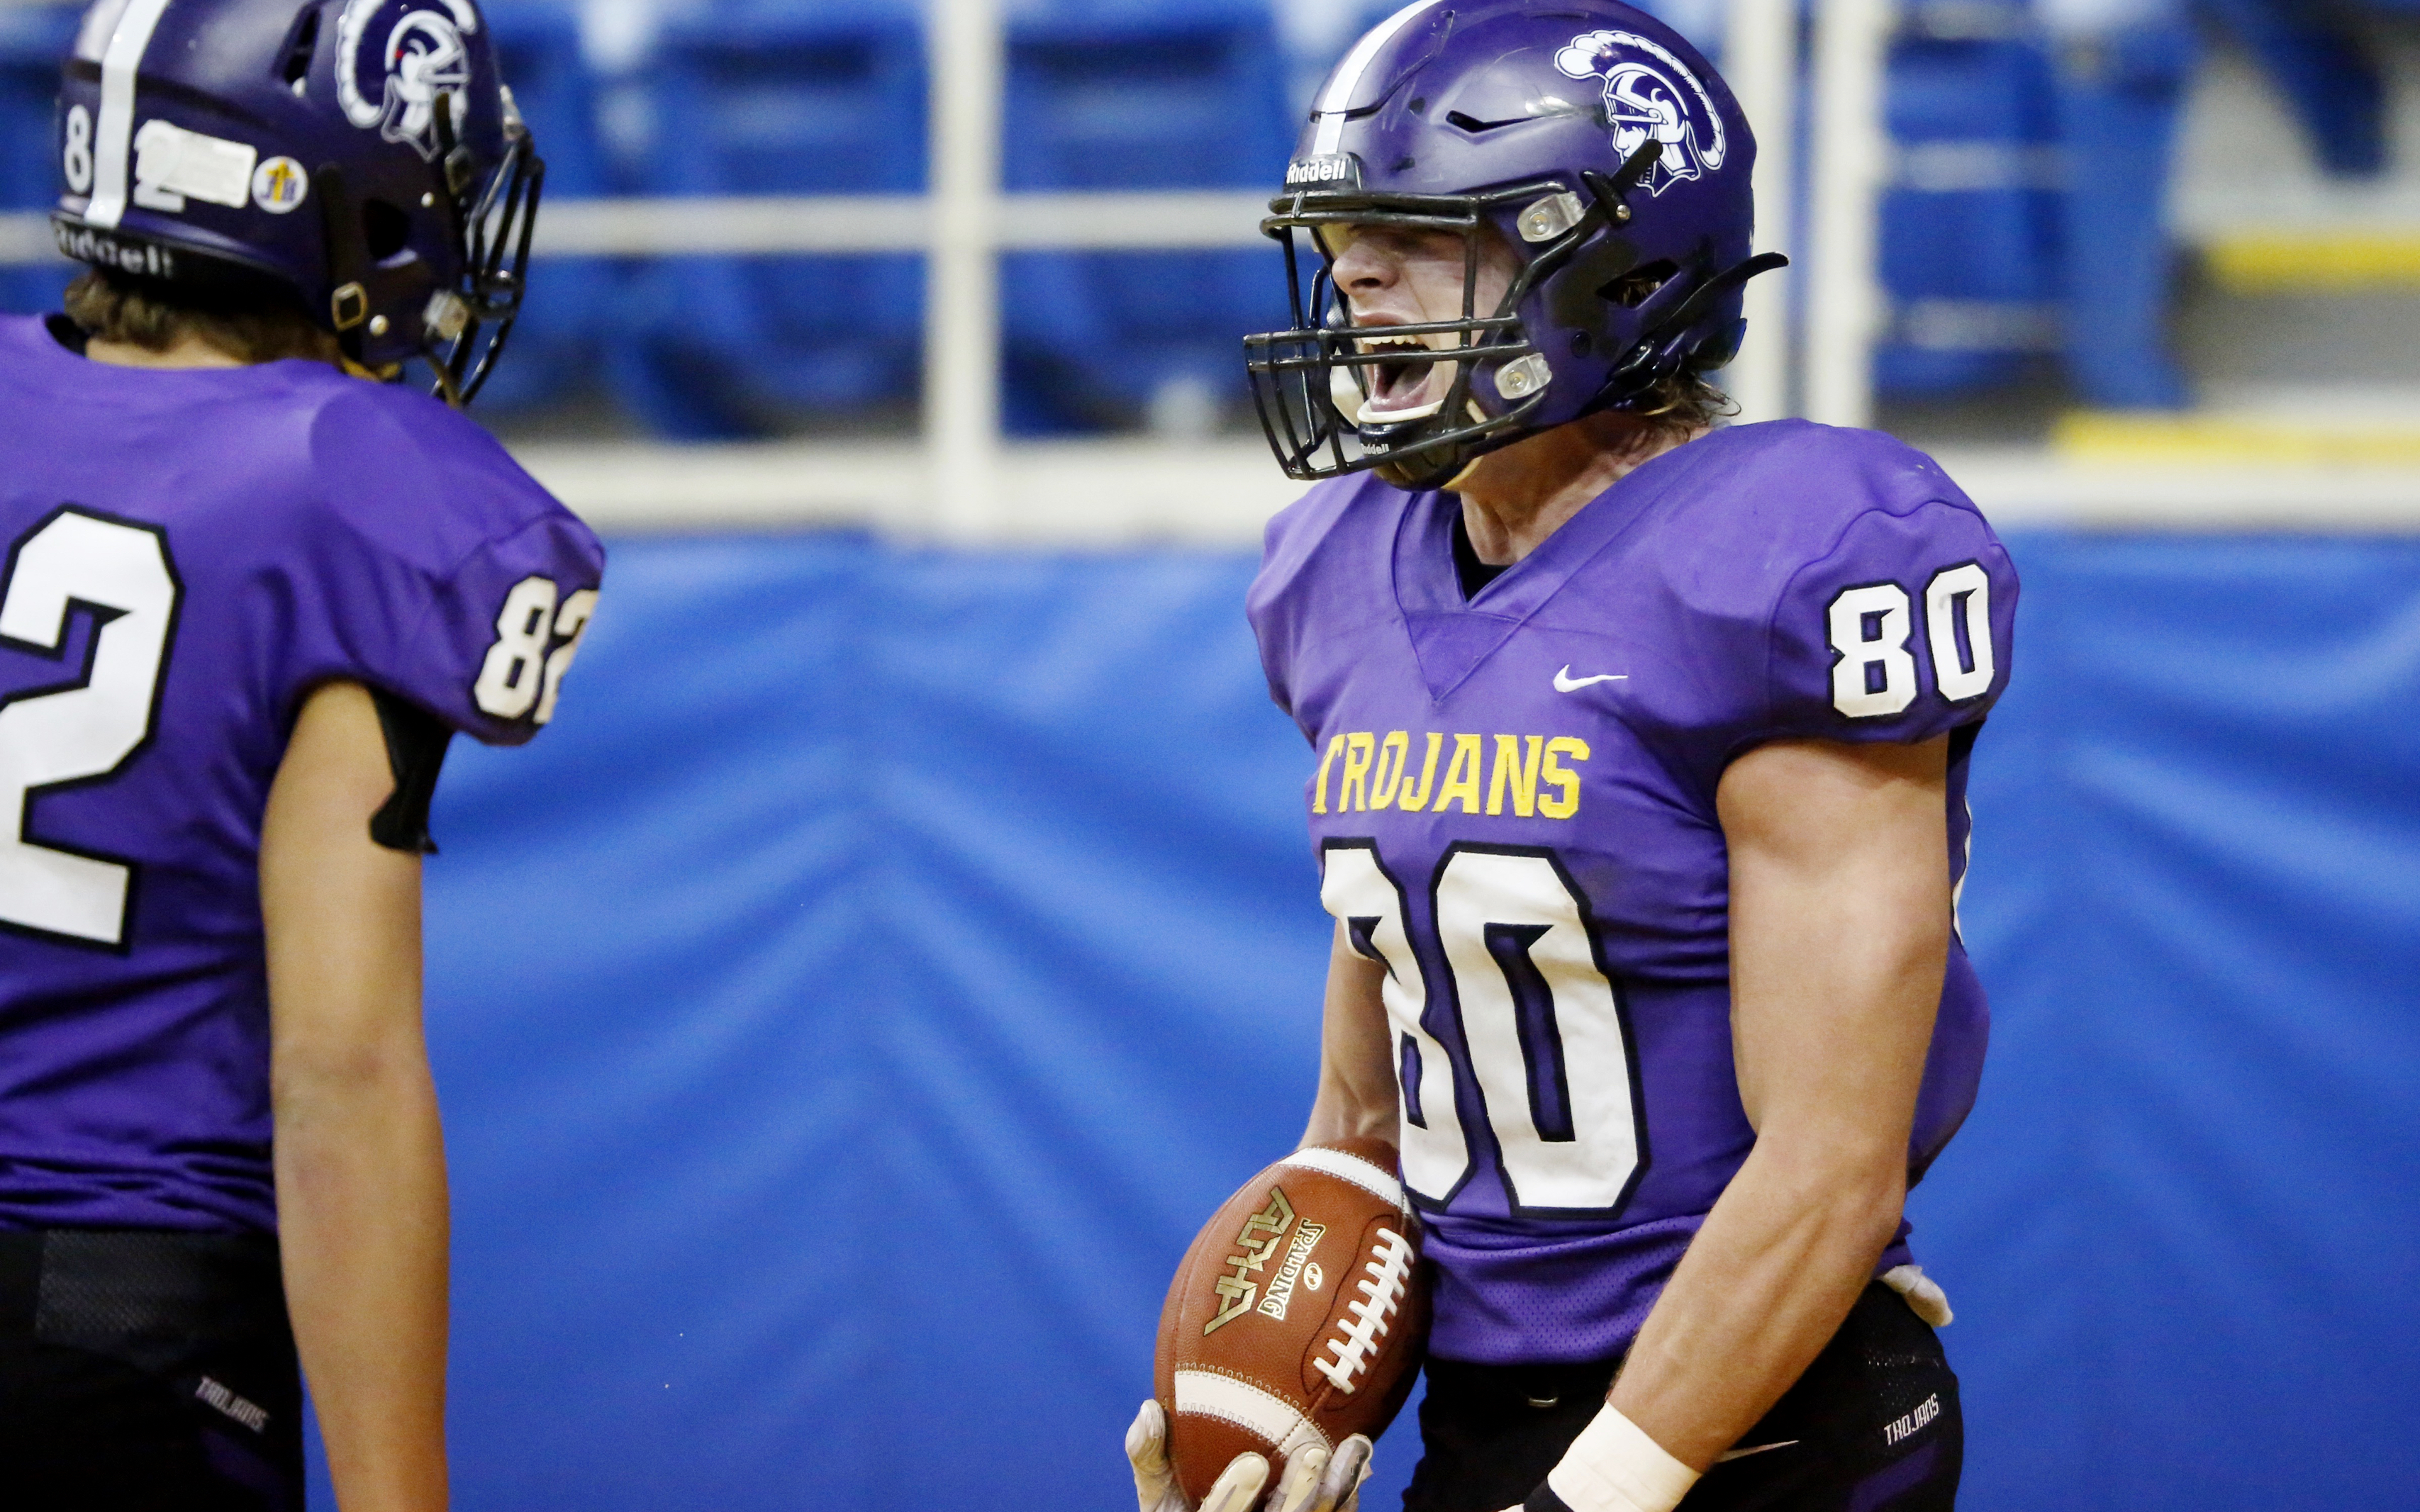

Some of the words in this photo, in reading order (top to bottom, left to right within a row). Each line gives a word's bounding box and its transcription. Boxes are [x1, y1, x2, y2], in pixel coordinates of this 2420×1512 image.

[1286, 159, 1346, 184] Riddell
[1828, 563, 1995, 718] 80
[1312, 729, 1590, 819] TROJANS
[1320, 847, 1641, 1209] 80
[1256, 1217, 1326, 1321] SPALDING
[1883, 1392, 1940, 1446] TROJANS
